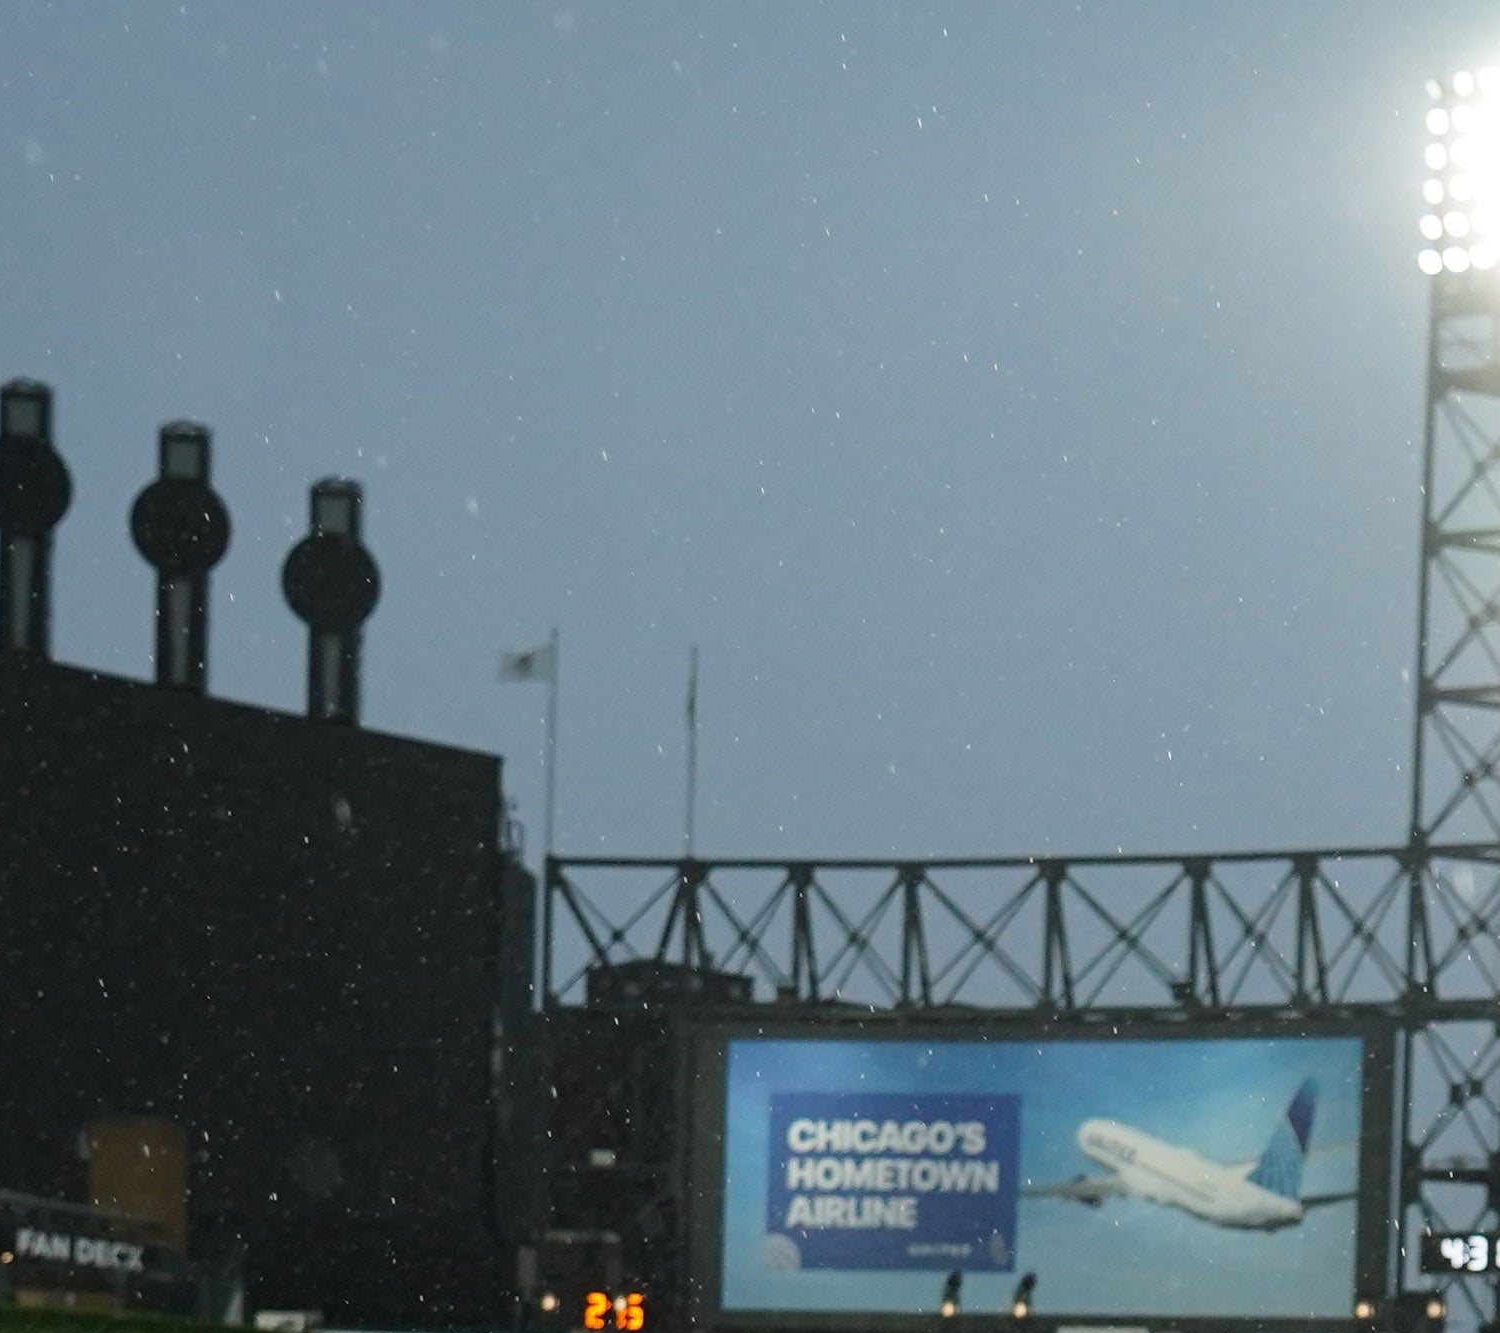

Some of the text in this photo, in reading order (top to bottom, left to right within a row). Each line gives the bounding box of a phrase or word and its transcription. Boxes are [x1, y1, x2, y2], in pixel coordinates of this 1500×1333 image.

[787, 1117, 987, 1155] CHICAGO'S
[786, 1157, 999, 1193] HOMETOWN
[785, 1195, 919, 1231] AIRLINE
[16, 1225, 145, 1272] FAN DECK
